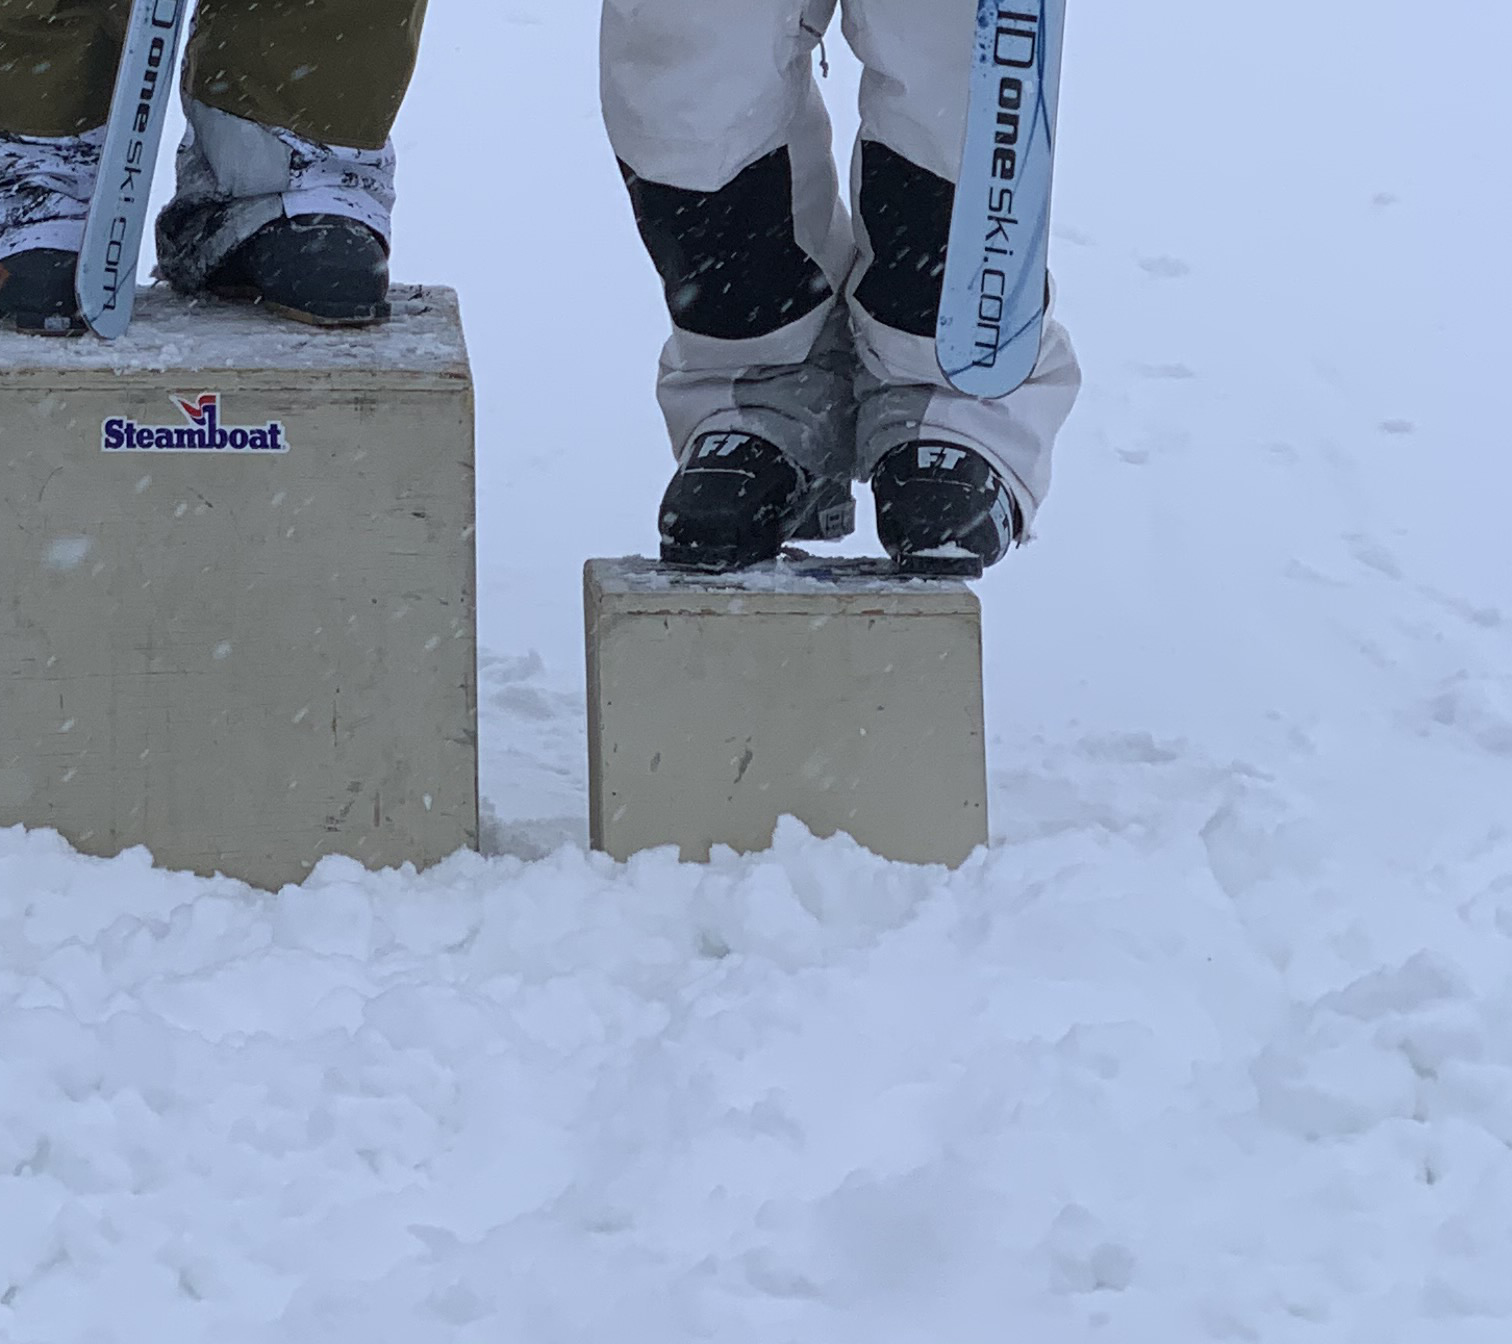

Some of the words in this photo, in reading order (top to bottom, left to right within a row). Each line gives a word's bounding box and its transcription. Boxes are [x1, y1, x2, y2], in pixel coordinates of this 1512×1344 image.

[104, 403, 282, 450] Steamboat
[697, 433, 751, 459] FT
[917, 446, 967, 470] FT
